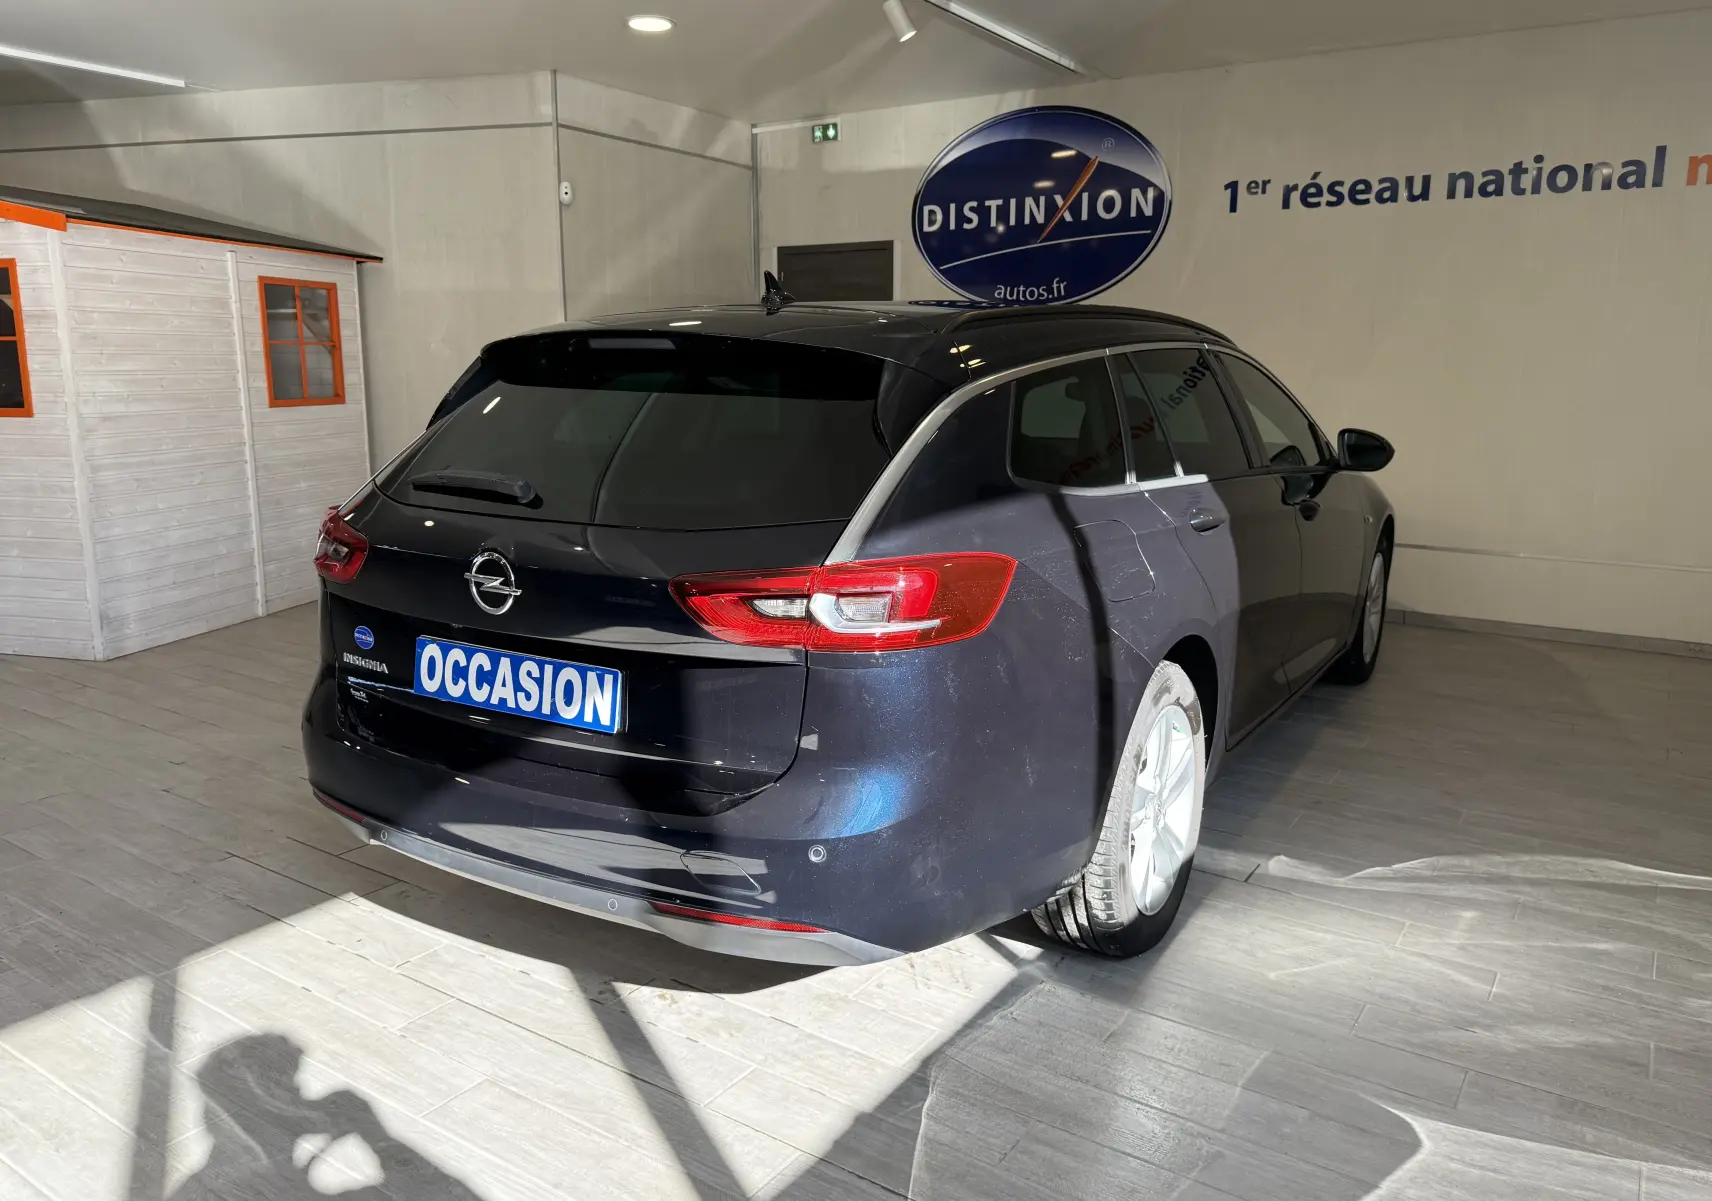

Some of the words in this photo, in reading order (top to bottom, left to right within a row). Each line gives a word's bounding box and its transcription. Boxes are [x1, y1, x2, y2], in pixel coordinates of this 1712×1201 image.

[1223, 179, 1271, 213] 1er
[1281, 171, 1432, 210] réseau
[1446, 145, 1667, 200] national
[922, 180, 1155, 236] DISTINXION
[994, 277, 1068, 301] autos.fr
[342, 652, 389, 674] INSIGNIA
[419, 642, 614, 727] OCCASION
